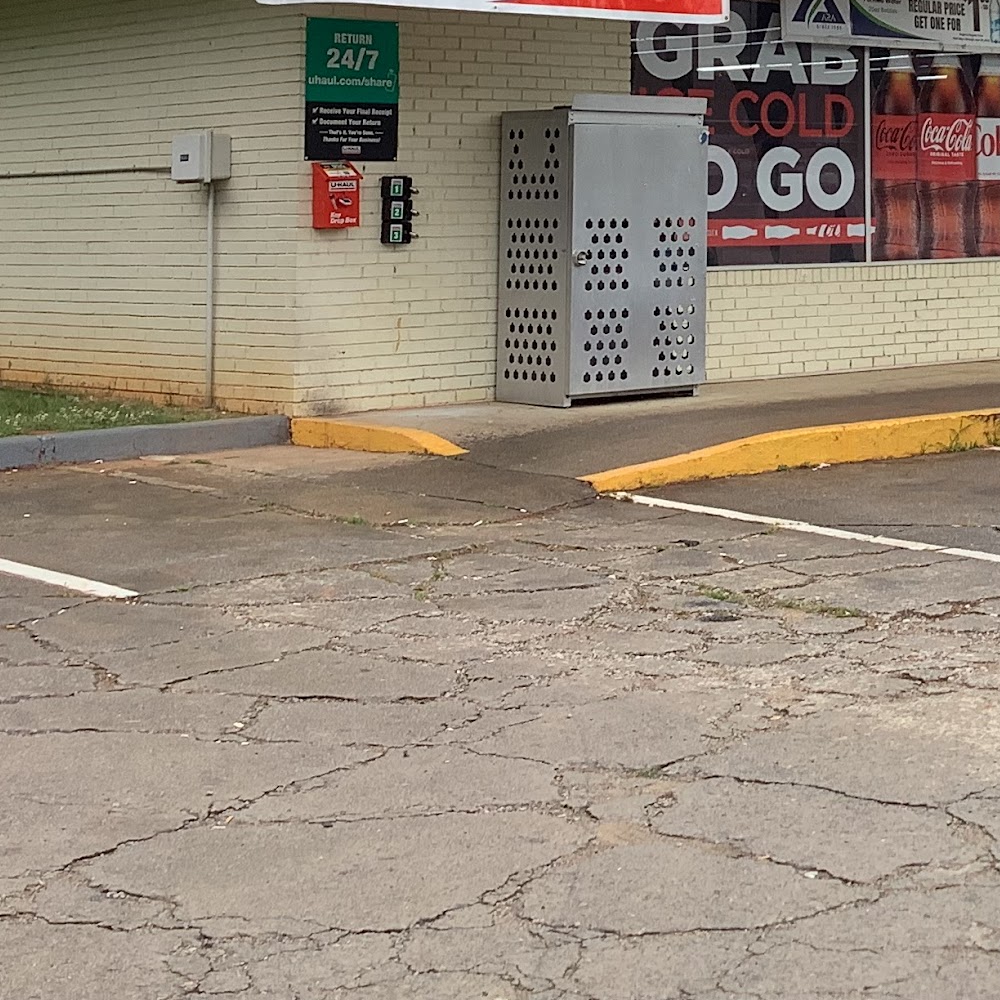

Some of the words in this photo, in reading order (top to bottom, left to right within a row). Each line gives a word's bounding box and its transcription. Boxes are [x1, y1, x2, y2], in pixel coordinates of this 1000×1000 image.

[908, 0, 942, 15] REGULAR
[944, 1, 965, 17] PRICE
[914, 15, 928, 29] GET
[930, 16, 945, 31] ONE
[947, 17, 961, 32] FOR
[334, 32, 373, 45] RETURN
[636, 11, 858, 85] GRAB
[326, 47, 379, 71] 24/7
[308, 75, 393, 88] uhaul.com/share
[342, 107, 356, 115] Your
[729, 90, 855, 138] COLD
[348, 118, 361, 126] Your
[876, 119, 918, 151] Coca-Co
[921, 117, 973, 152] Coca-Cola
[756, 146, 856, 212] GO
[394, 185, 399, 193] 1
[394, 209, 400, 217] 2
